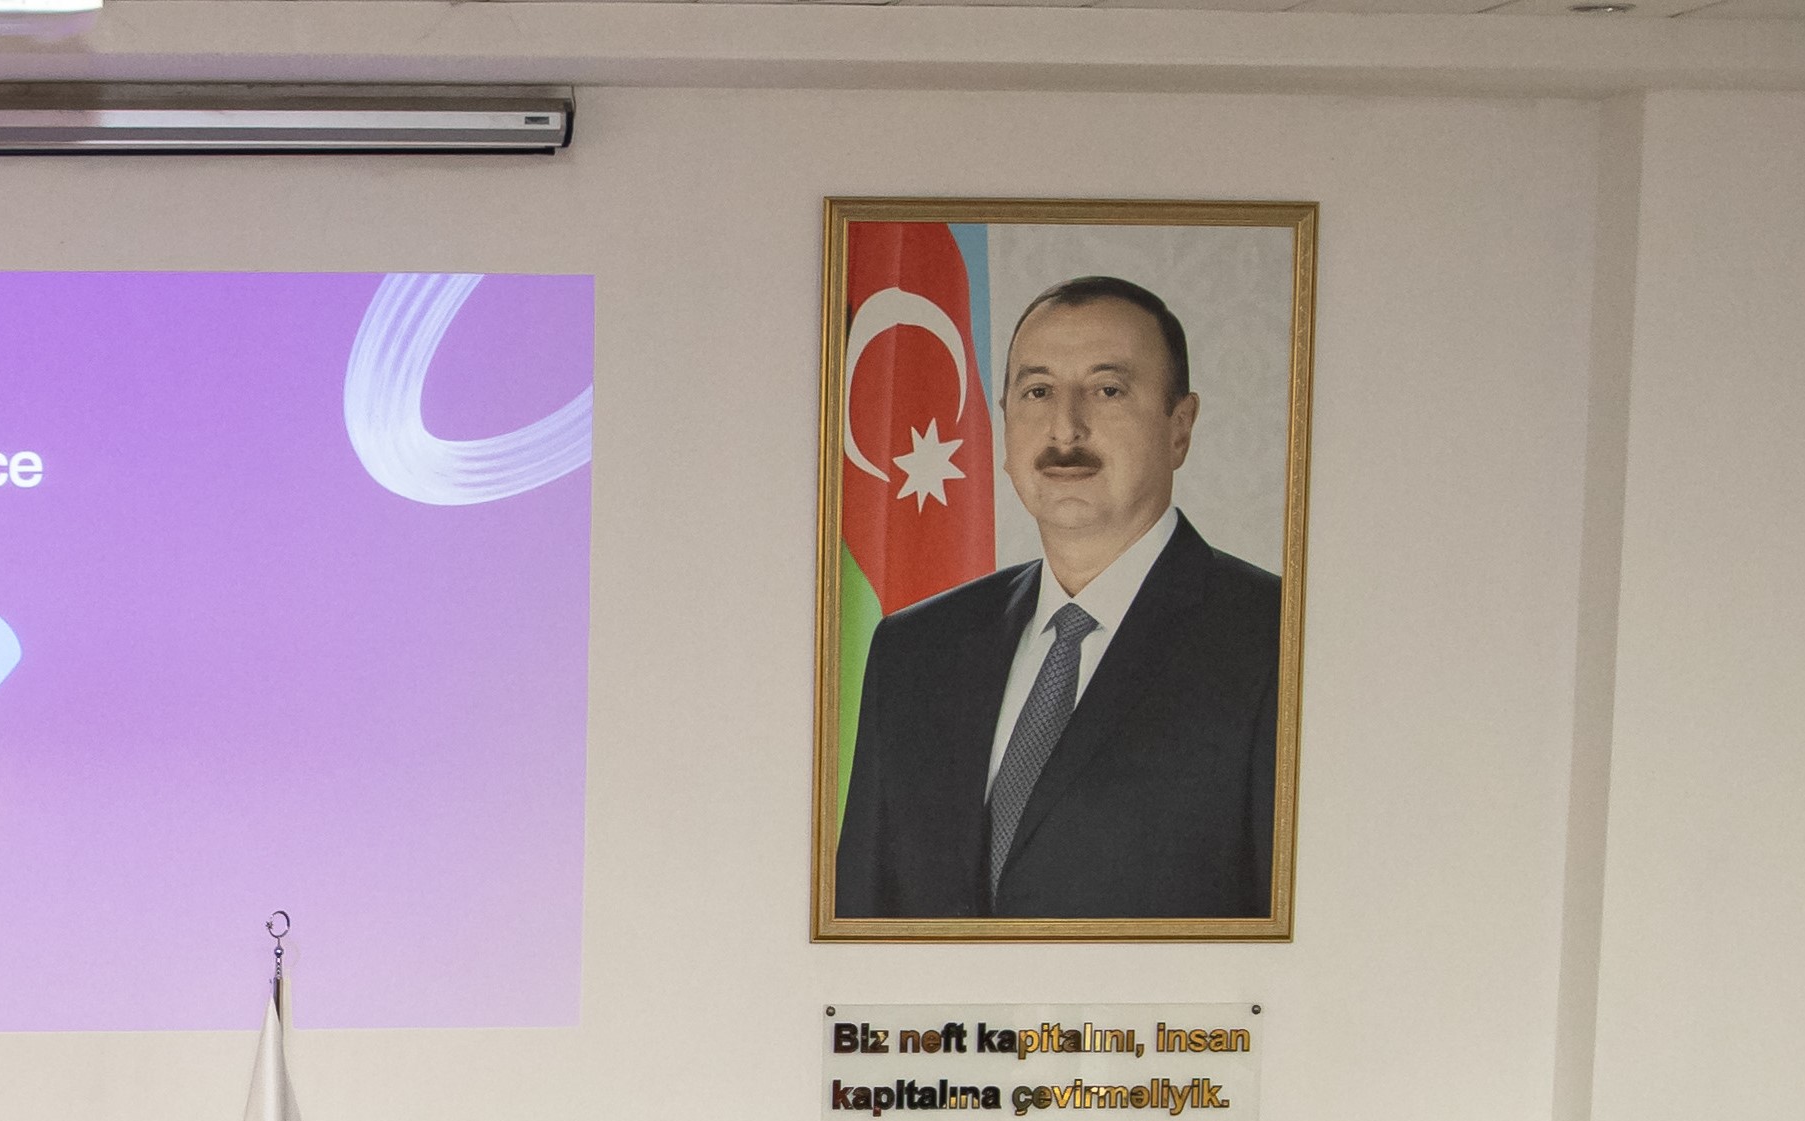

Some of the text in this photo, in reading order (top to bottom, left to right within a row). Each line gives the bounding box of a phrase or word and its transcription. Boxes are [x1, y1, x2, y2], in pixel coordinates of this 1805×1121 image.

[834, 1021, 1251, 1060] Biz neft kapitalını, insan
[832, 1078, 1230, 1117] kapitalına çevirməliyik.
